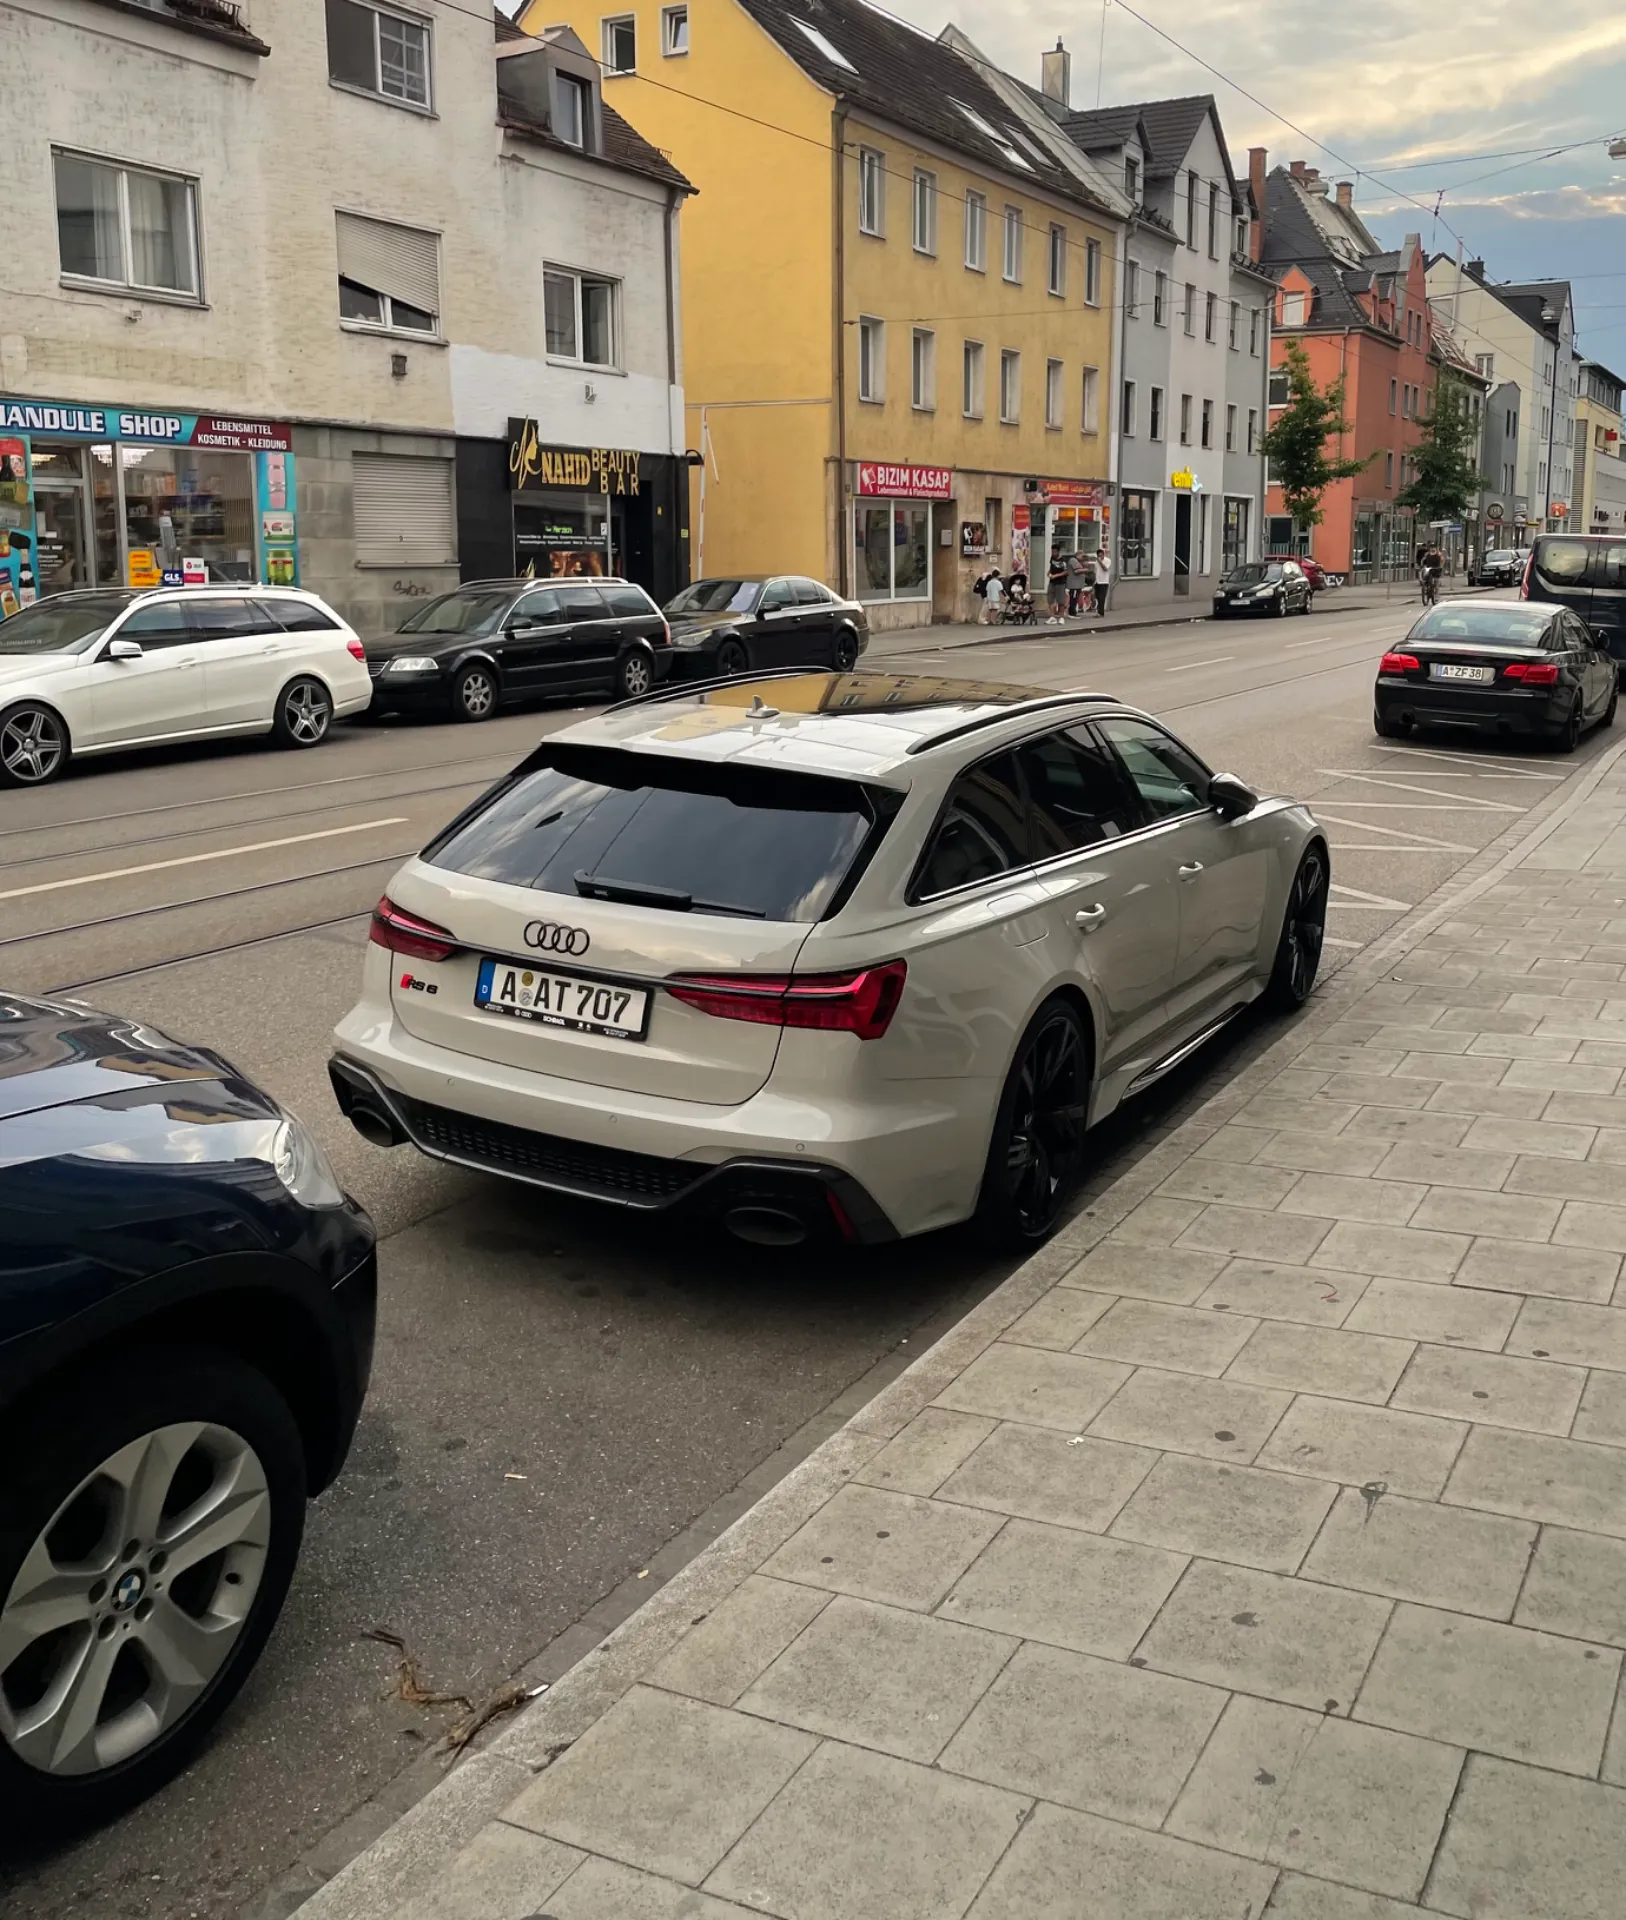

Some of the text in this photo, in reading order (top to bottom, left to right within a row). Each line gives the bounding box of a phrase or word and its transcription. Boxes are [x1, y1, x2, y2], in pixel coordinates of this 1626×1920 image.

[120, 414, 180, 437] SHOP
[211, 420, 273, 435] LEBENSMITTEL
[197, 434, 240, 446] KOSMETIK
[248, 438, 287, 450] KLEIDUNG
[541, 451, 591, 486] NAHID
[591, 448, 640, 474] BEAUTY
[600, 471, 640, 496] BAR
[877, 466, 949, 489] BIZIM KASAP
[481, 970, 632, 1024] D A AT 707
